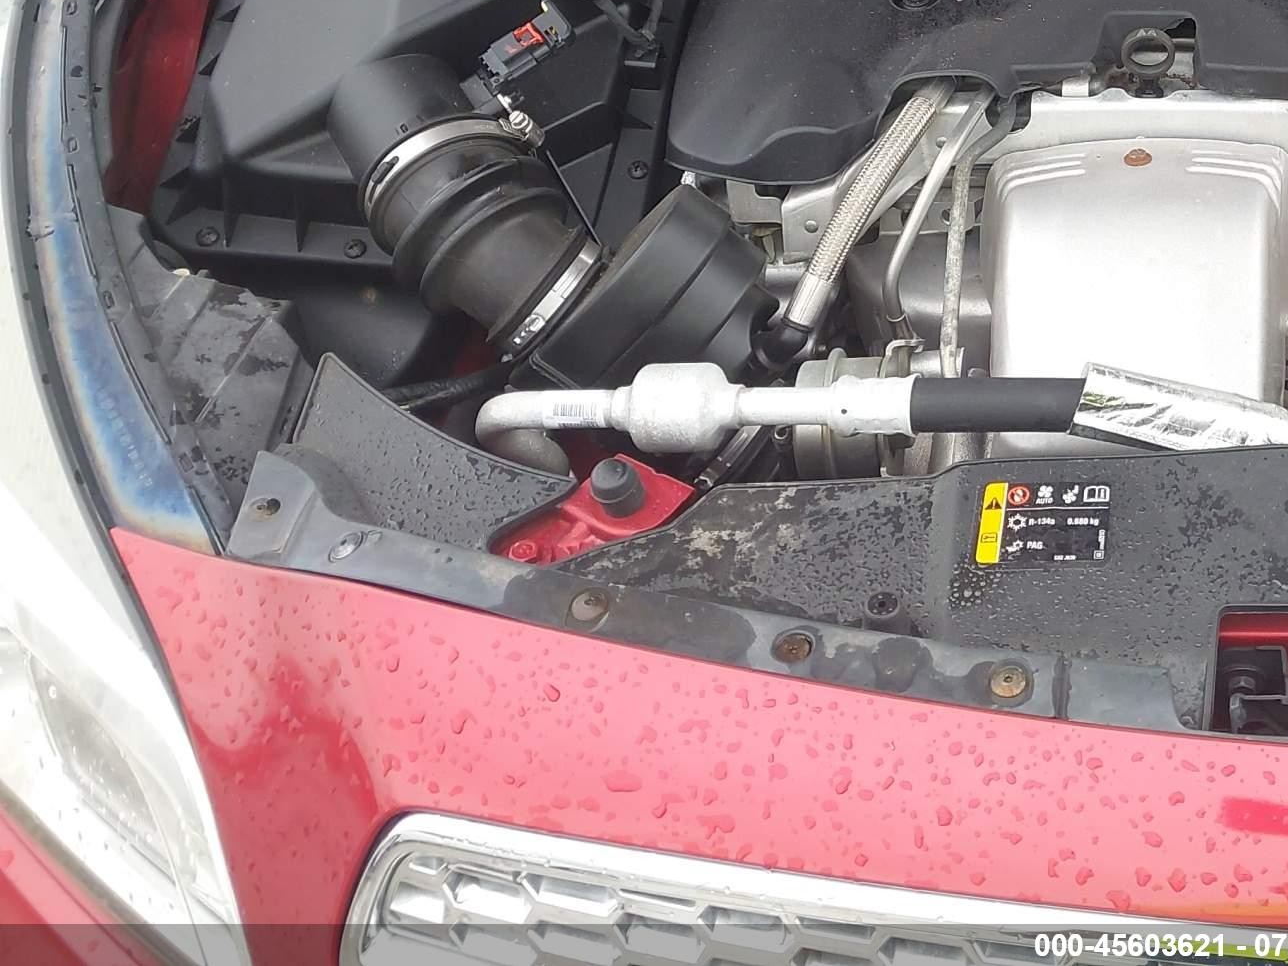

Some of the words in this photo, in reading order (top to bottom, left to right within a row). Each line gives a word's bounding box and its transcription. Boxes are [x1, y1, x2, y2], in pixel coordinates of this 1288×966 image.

[1028, 518, 1055, 526] R-134a
[1089, 517, 1100, 527] kg
[1027, 541, 1043, 549] PAG
